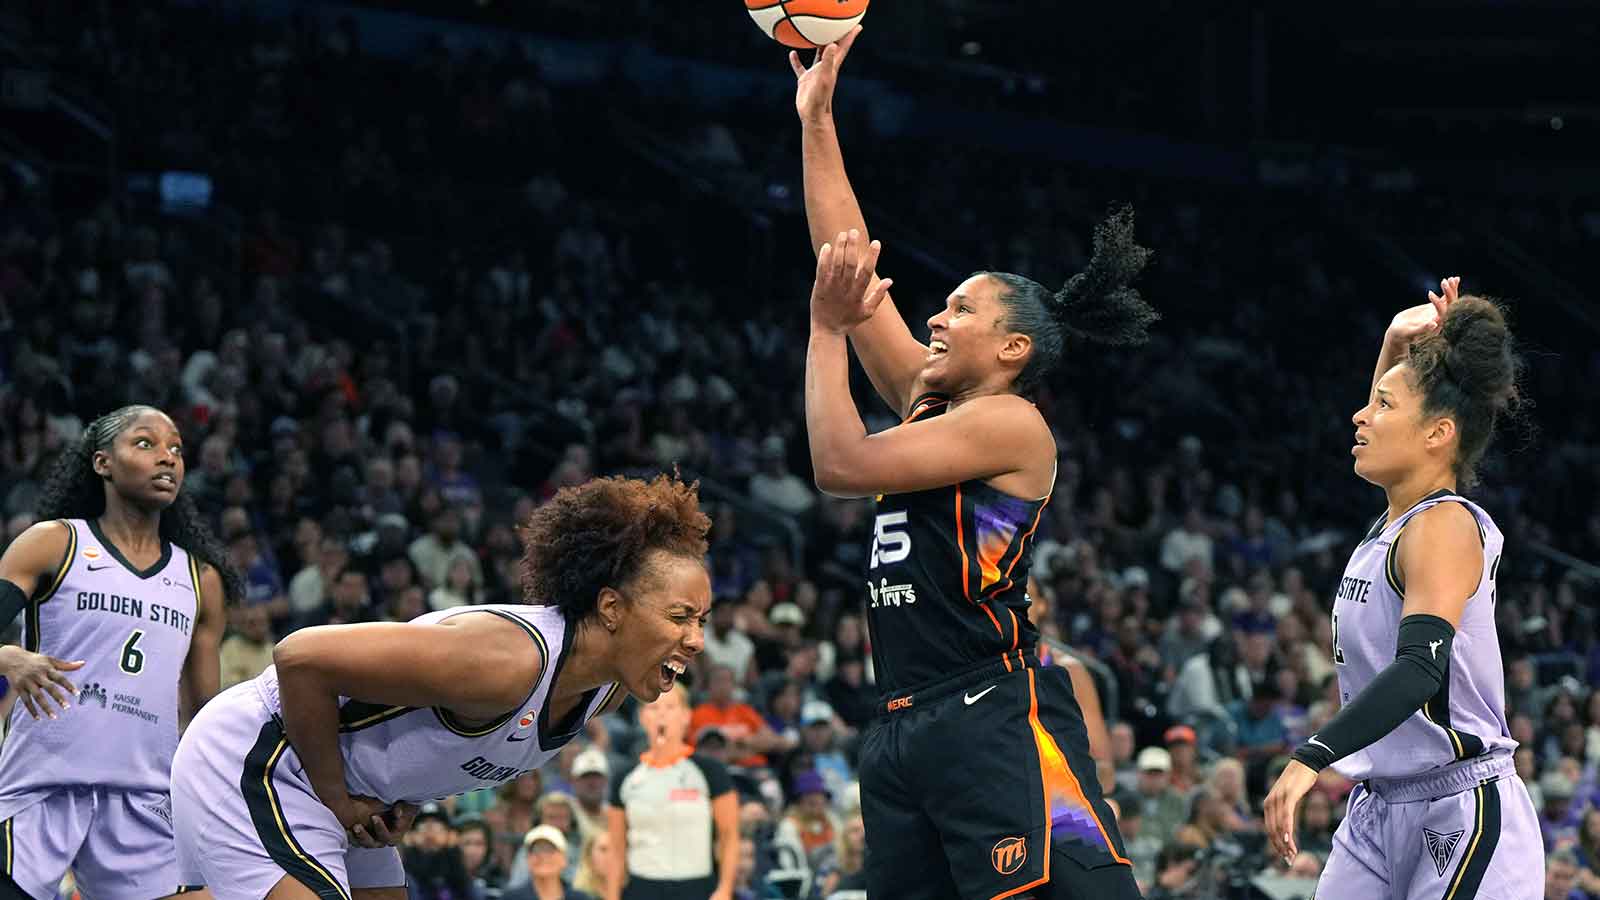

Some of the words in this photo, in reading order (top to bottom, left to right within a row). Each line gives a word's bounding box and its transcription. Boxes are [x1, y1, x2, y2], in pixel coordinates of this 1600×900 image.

[1338, 576, 1372, 604] STATE
[76, 591, 143, 618] GOLDEN
[150, 604, 191, 636] STATE
[119, 629, 145, 676] 6
[114, 693, 142, 707] KAISER
